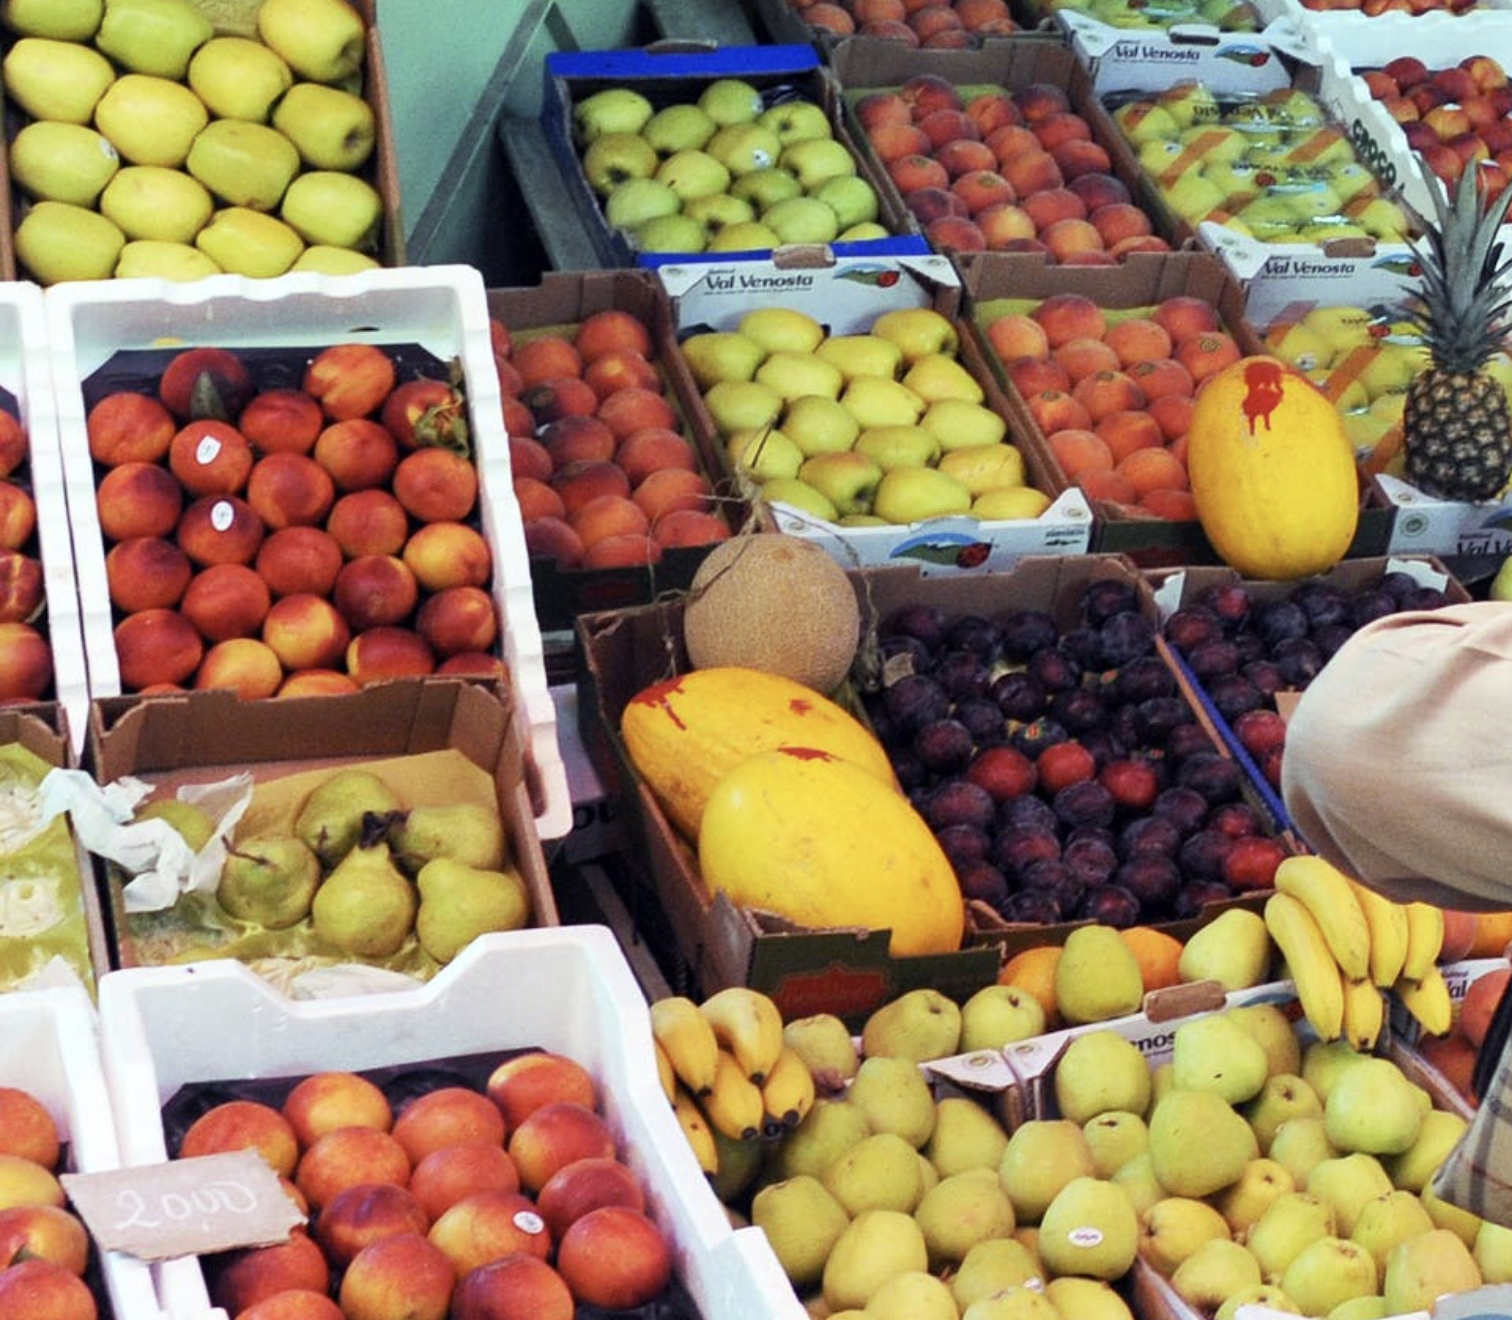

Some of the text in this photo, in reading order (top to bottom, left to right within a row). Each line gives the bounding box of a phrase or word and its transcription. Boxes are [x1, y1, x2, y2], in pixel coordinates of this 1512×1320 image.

[1115, 44, 1200, 60] Val Venosta
[1264, 261, 1355, 274] Val Venosta
[706, 274, 814, 290] Val Venosta
